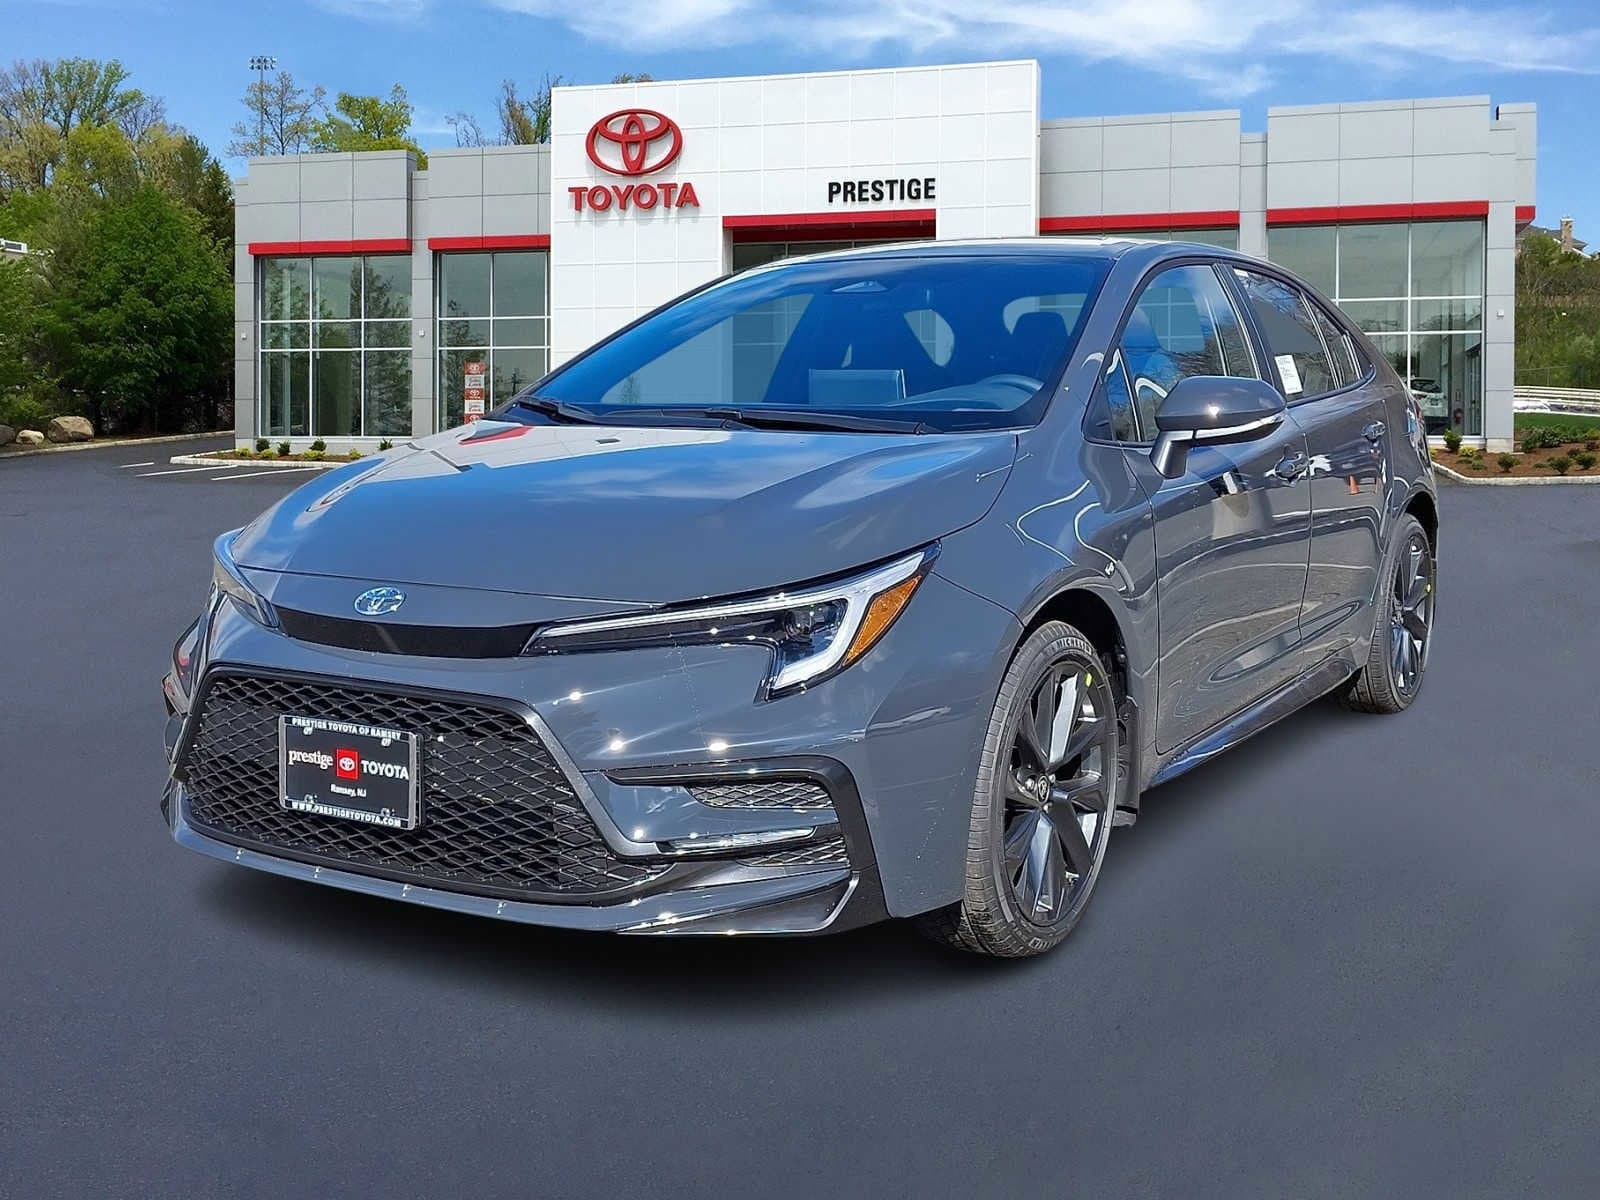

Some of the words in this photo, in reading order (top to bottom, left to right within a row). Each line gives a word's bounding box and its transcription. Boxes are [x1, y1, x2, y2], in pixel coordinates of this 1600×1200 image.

[568, 182, 700, 212] TOYOTA
[828, 178, 936, 202] PRESTIGE
[291, 717, 327, 729] PRESTIGE
[328, 722, 357, 734] TOYOTA
[359, 726, 369, 735] OF
[370, 728, 401, 740] RAMSEY
[288, 750, 333, 769] prestige
[361, 760, 409, 780] TOYOTA
[357, 788, 367, 797] NJ
[291, 801, 401, 827] WWW.PRESTIGETOYOTA.COM
